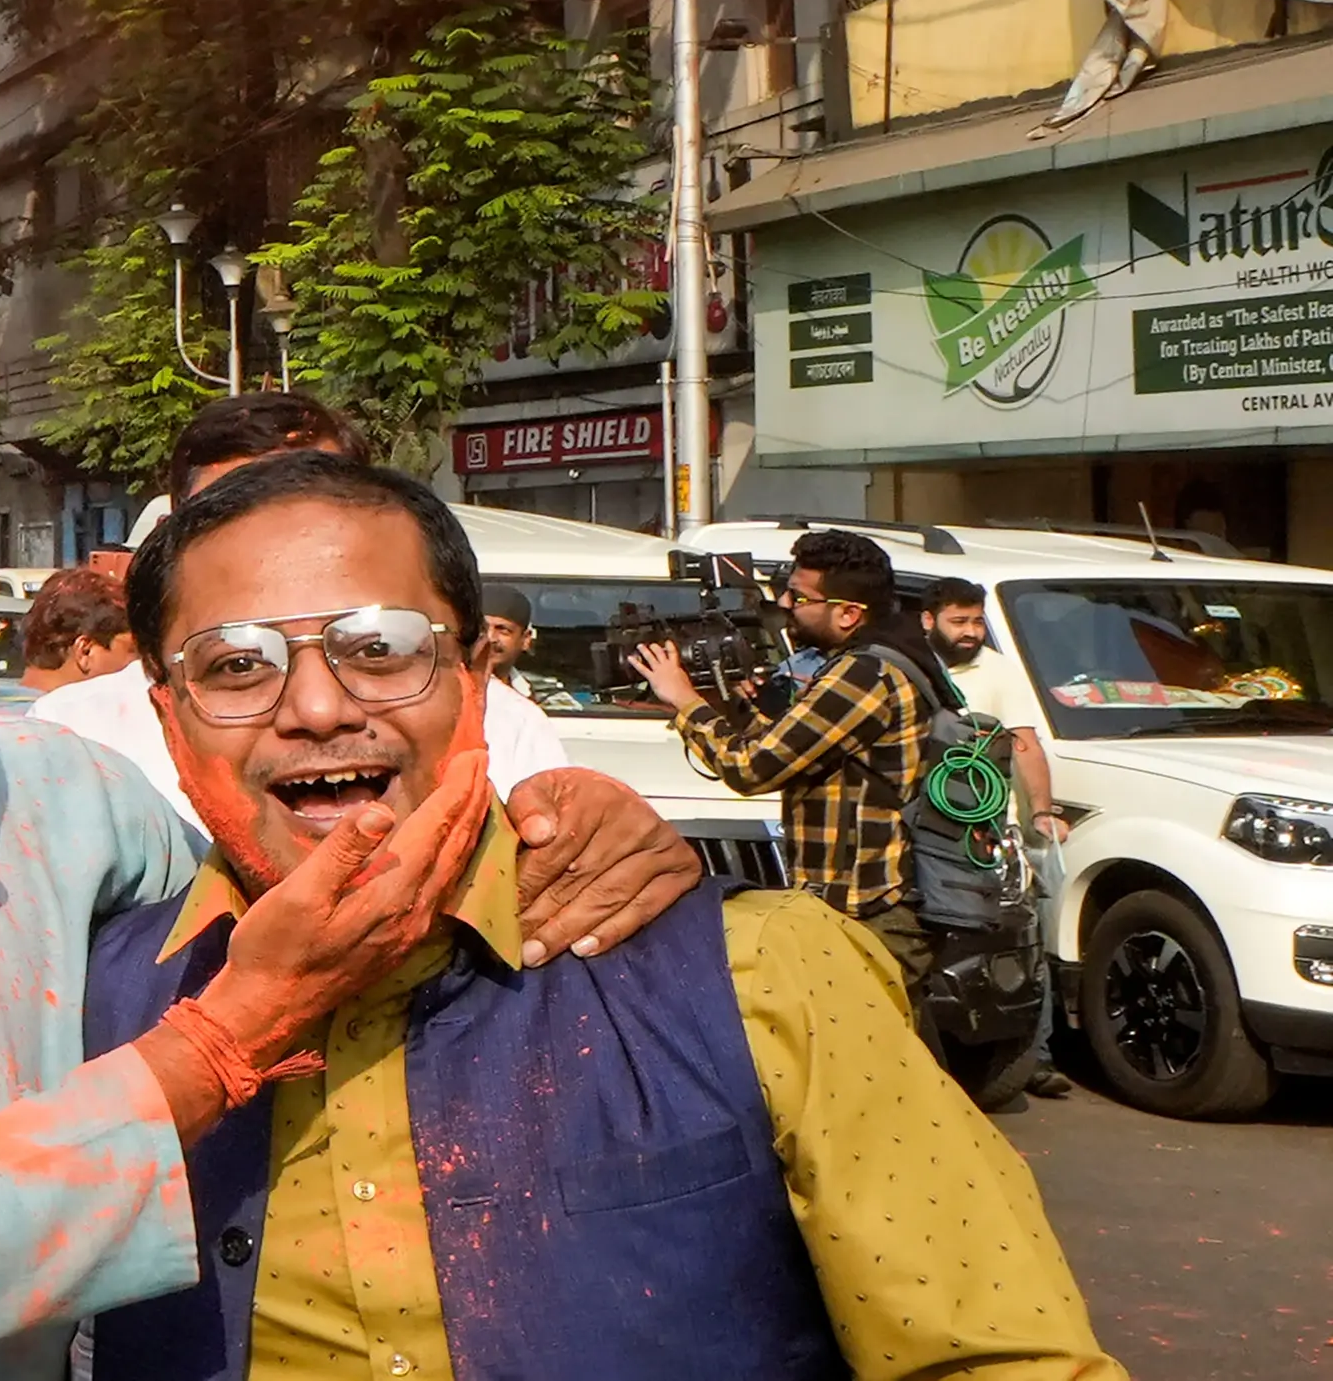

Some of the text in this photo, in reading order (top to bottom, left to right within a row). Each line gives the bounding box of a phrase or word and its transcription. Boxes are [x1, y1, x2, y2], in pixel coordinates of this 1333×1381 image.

[1237, 264, 1299, 289] HEALTH
[957, 265, 1071, 367] Be Healthy
[1150, 311, 1206, 334] Awarded
[1209, 314, 1223, 328] as
[1260, 304, 1305, 323] Safest
[994, 324, 1052, 387] Naturally
[1160, 327, 1333, 358] for Treating Lakhs of Pati
[1183, 363, 1207, 384] (By
[1209, 359, 1258, 380] Central
[1261, 357, 1326, 376] Minister,
[1242, 394, 1309, 412] CENTRAL
[503, 423, 554, 455] FIRE
[561, 416, 651, 449] SHIELD
